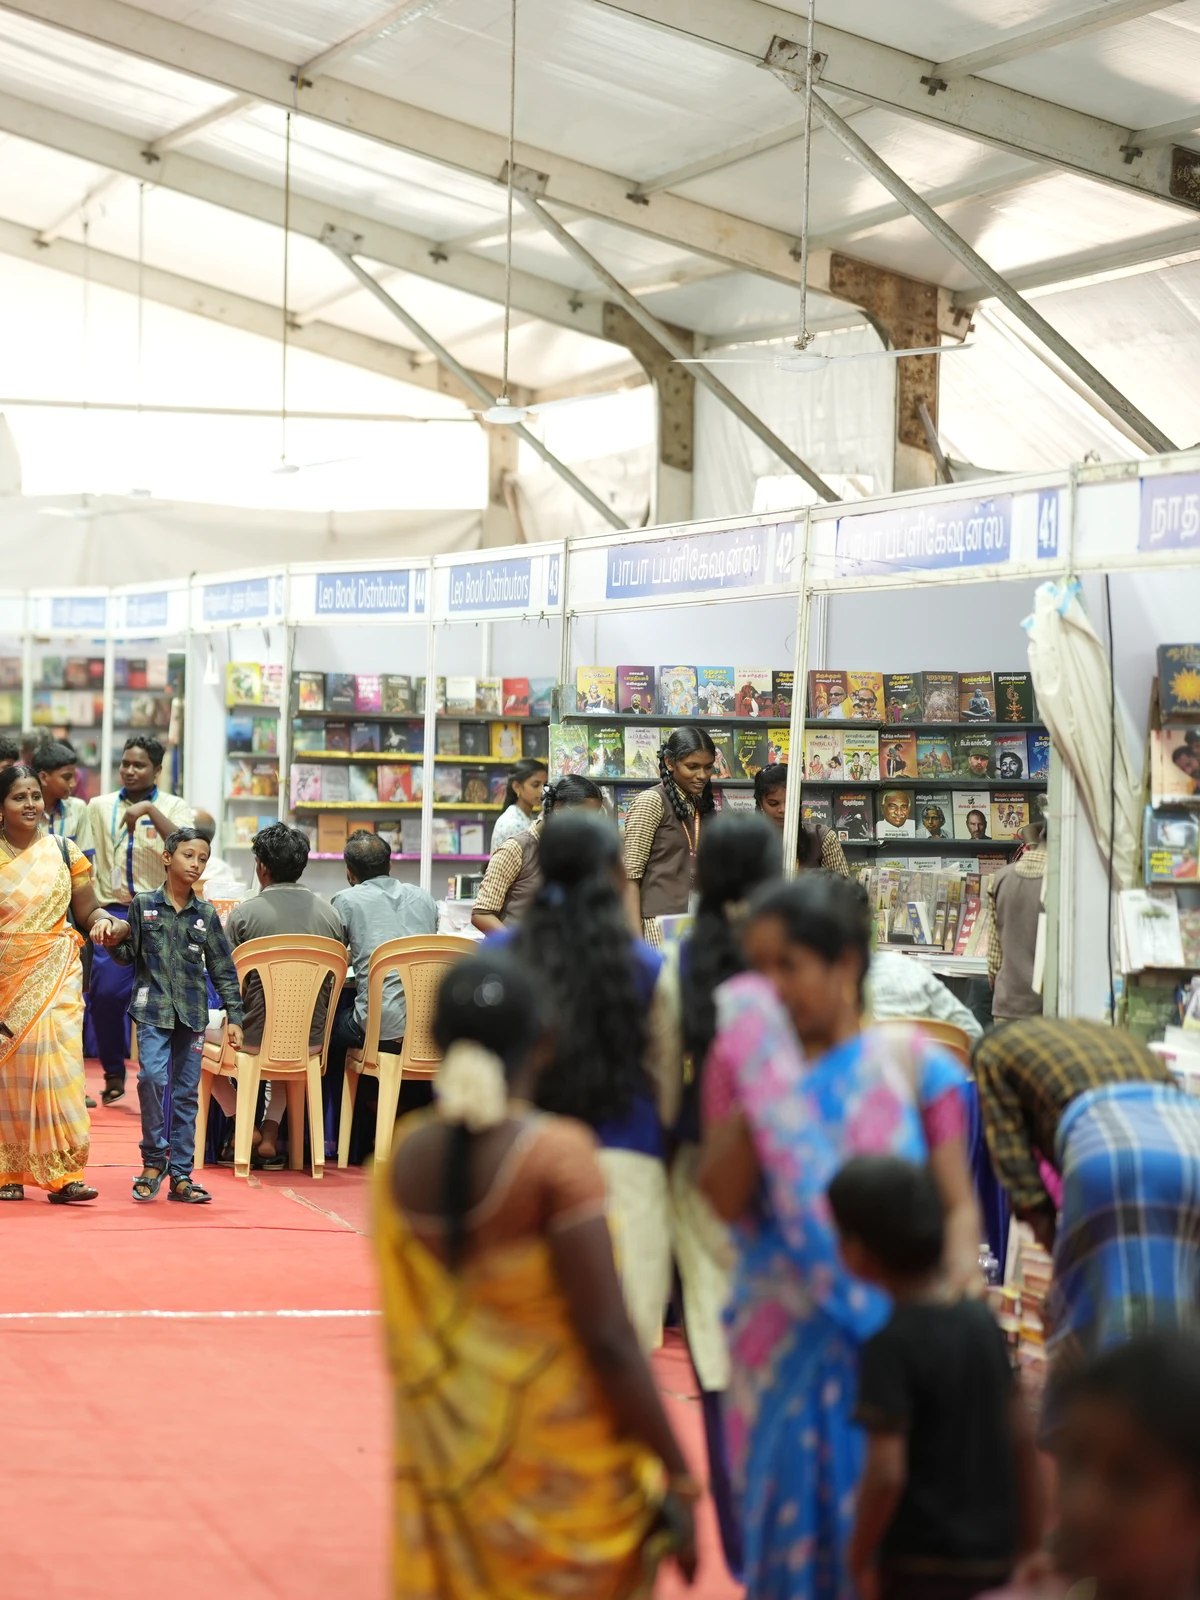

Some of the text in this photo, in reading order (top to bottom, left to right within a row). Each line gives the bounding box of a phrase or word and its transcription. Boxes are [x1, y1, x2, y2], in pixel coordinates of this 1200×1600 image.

[885, 504, 1003, 562] பப்ளிகேஷன்ஸ்
[1039, 498, 1057, 548] 41
[611, 535, 761, 586] பாபா பப்ளிகேஷன்ஸ்
[776, 532, 793, 573] 42
[318, 577, 406, 609] Leo Book Distributors
[415, 572, 425, 605] 44
[451, 565, 529, 605] Leo Book Distributors
[549, 560, 558, 596] 43
